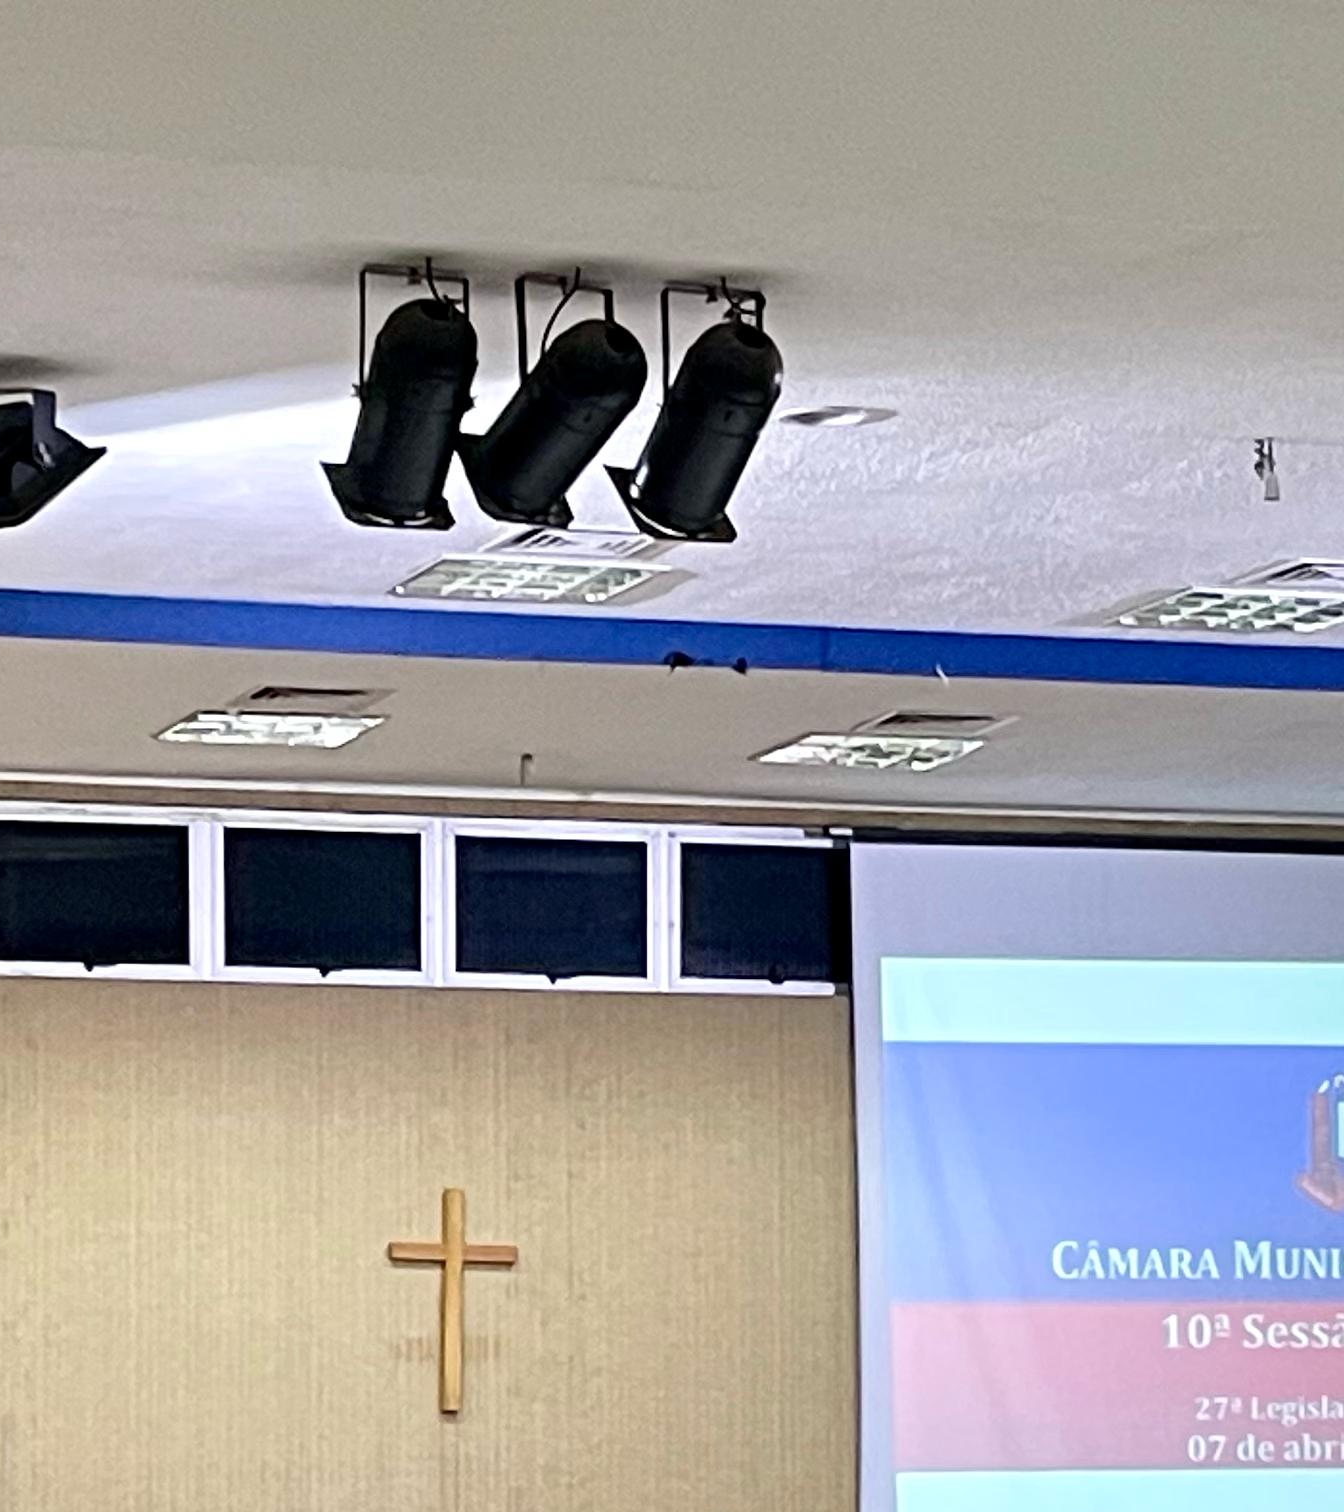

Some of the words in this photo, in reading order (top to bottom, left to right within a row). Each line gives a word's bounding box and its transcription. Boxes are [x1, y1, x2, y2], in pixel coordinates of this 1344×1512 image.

[1052, 1240, 1220, 1280] CÂMARA
[1162, 1313, 1230, 1349] 10ª
[1187, 1433, 1227, 1462] 07
[1236, 1433, 1276, 1462] de
